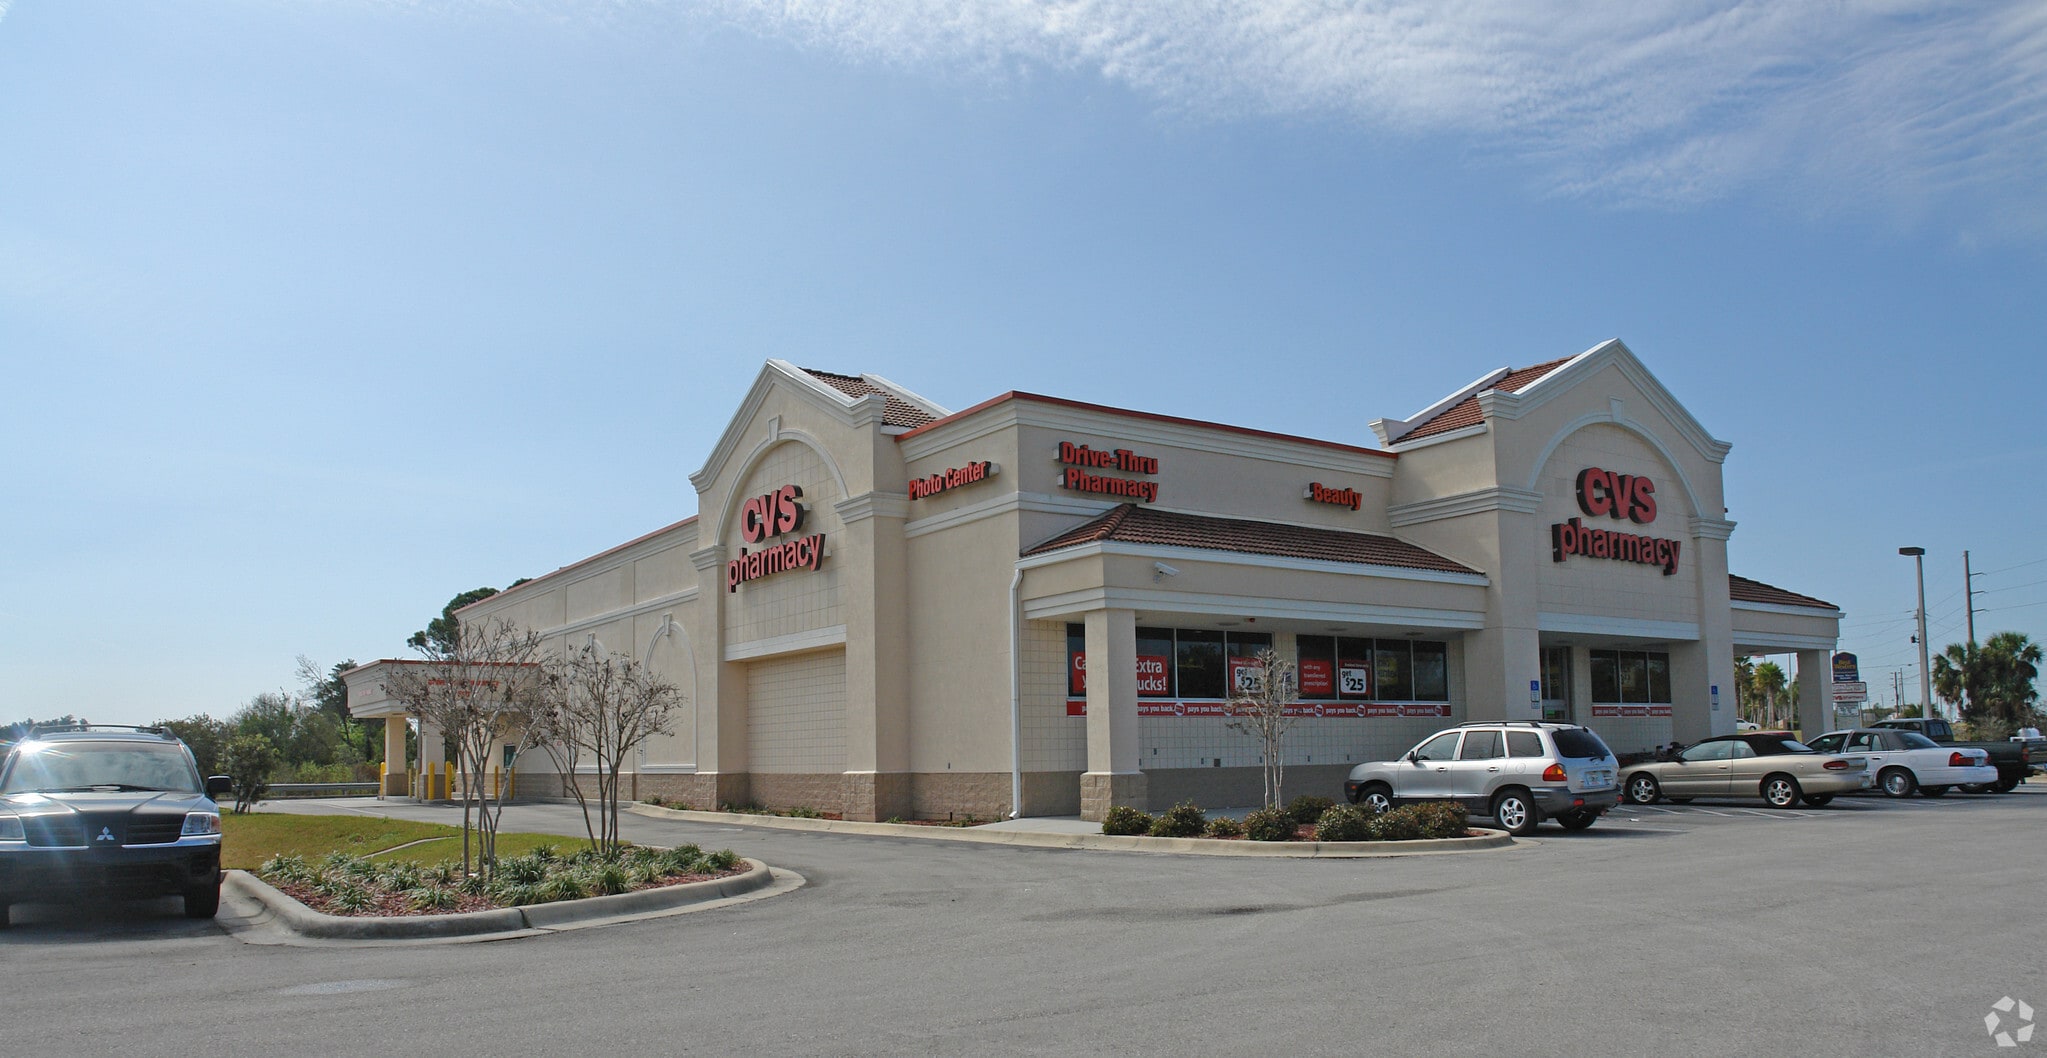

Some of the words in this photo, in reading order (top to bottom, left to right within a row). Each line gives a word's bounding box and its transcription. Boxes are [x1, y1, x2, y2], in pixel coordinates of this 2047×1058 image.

[1060, 441, 1158, 474] Drive-Thru
[908, 474, 943, 501] Photo
[945, 461, 990, 489] Center
[1064, 468, 1159, 503] Pharmacy
[1310, 481, 1362, 511] Beauty
[1576, 467, 1657, 524] CVS
[741, 484, 804, 543] CVS
[728, 533, 826, 593] pharmacy
[1552, 517, 1681, 576] pharmacy
[1137, 675, 1167, 691] ucks!
[1341, 670, 1352, 679] get
[1345, 677, 1364, 691] $25
